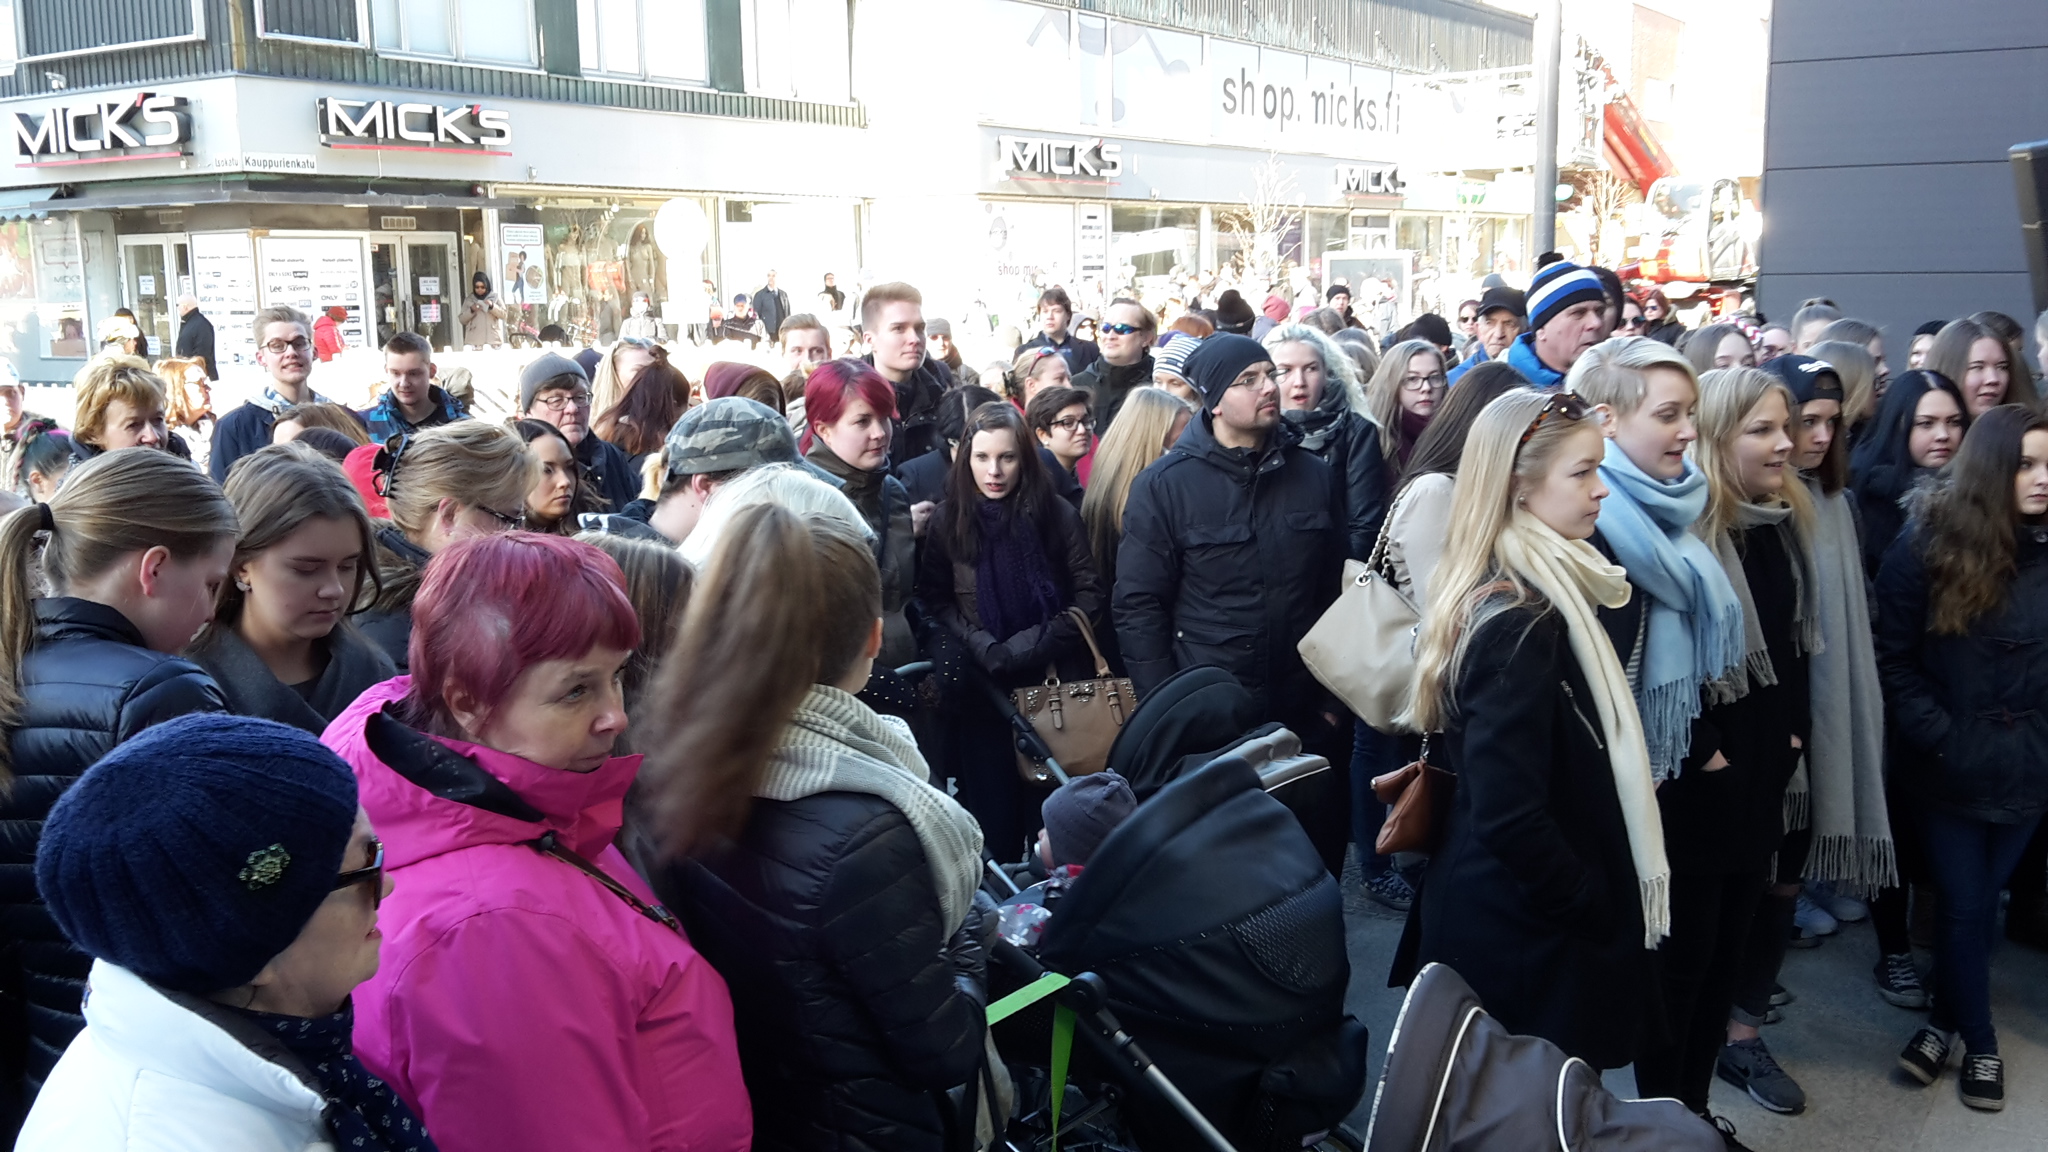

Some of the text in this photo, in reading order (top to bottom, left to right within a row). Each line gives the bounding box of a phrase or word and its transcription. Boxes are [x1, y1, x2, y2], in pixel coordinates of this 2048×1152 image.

[12, 92, 182, 155] MICK'S
[327, 96, 512, 146] MICK'S
[245, 155, 315, 170] Kauppurienkatu
[1003, 135, 1123, 178] MICK'S
